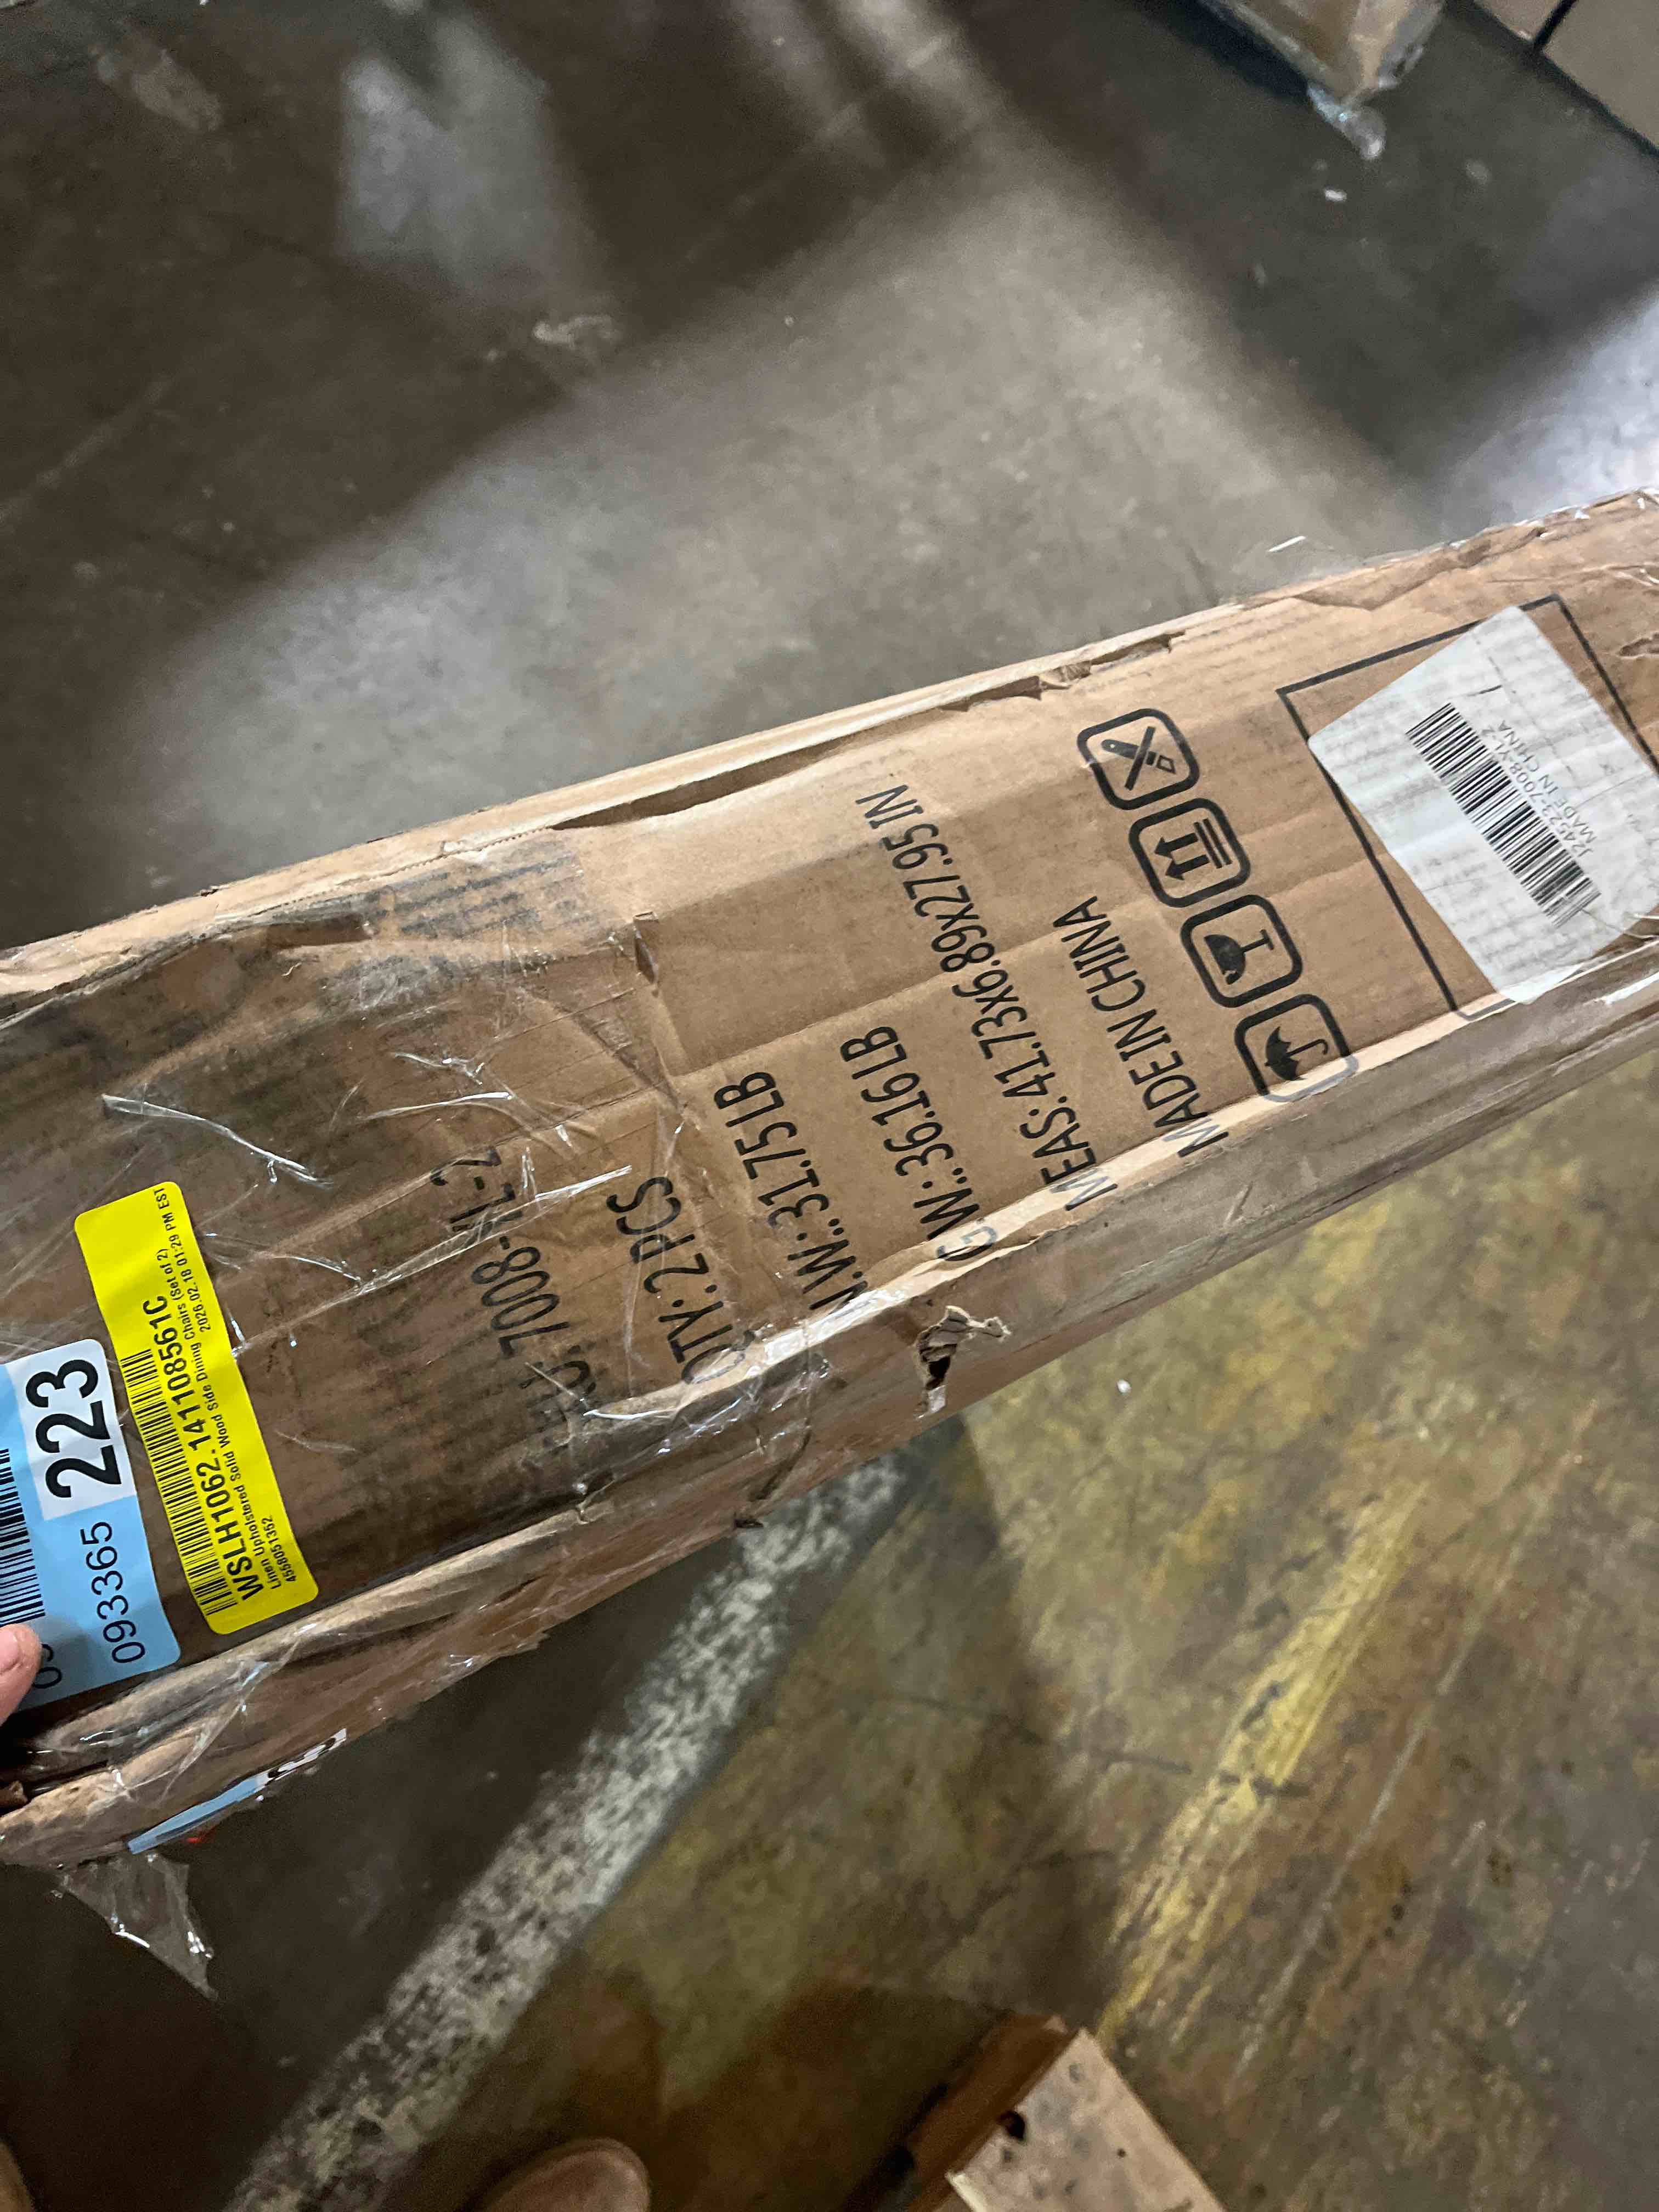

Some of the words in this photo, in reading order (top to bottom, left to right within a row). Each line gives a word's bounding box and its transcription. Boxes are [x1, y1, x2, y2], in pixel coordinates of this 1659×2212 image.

[1499, 719, 1541, 772] CHINA
[856, 780, 924, 833] IN
[1538, 773, 1558, 793] IN
[1555, 796, 1597, 843] MADE
[881, 817, 1056, 1098] 41.73x6.89x27.95
[1051, 894, 1147, 1015] CHINA
[837, 1020, 907, 1080] LB
[1106, 1006, 1172, 1063] IN
[714, 1066, 785, 1127] LB
[859, 1068, 957, 1177] 36.16
[1127, 1049, 1230, 1158] MADE
[734, 1117, 831, 1230] 31.75
[1018, 1094, 1118, 1211] MEAS:
[153, 1188, 170, 1209] EST
[161, 1211, 176, 1231] PM
[606, 1172, 695, 1265] PCS
[155, 1248, 167, 1260] 2)
[160, 1262, 173, 1274] of
[168, 1233, 187, 1265] 01:29
[643, 1252, 709, 1295] 2
[167, 1276, 184, 1300] (Set
[180, 1268, 210, 1332] 2026.02.18
[177, 1302, 195, 1339] Chairs
[658, 1283, 755, 1386] QTY:
[190, 1342, 208, 1381] Dining
[202, 1384, 218, 1410] Side
[26, 1359, 121, 1498] 223
[143, 1296, 263, 1600] WSLH1062.141108561C
[211, 1413, 230, 1447] Wood
[223, 1451, 240, 1481] Solid
[234, 1484, 264, 1556] Upholstered
[80, 1522, 145, 1663] 093365
[259, 1558, 280, 1589] Linen
